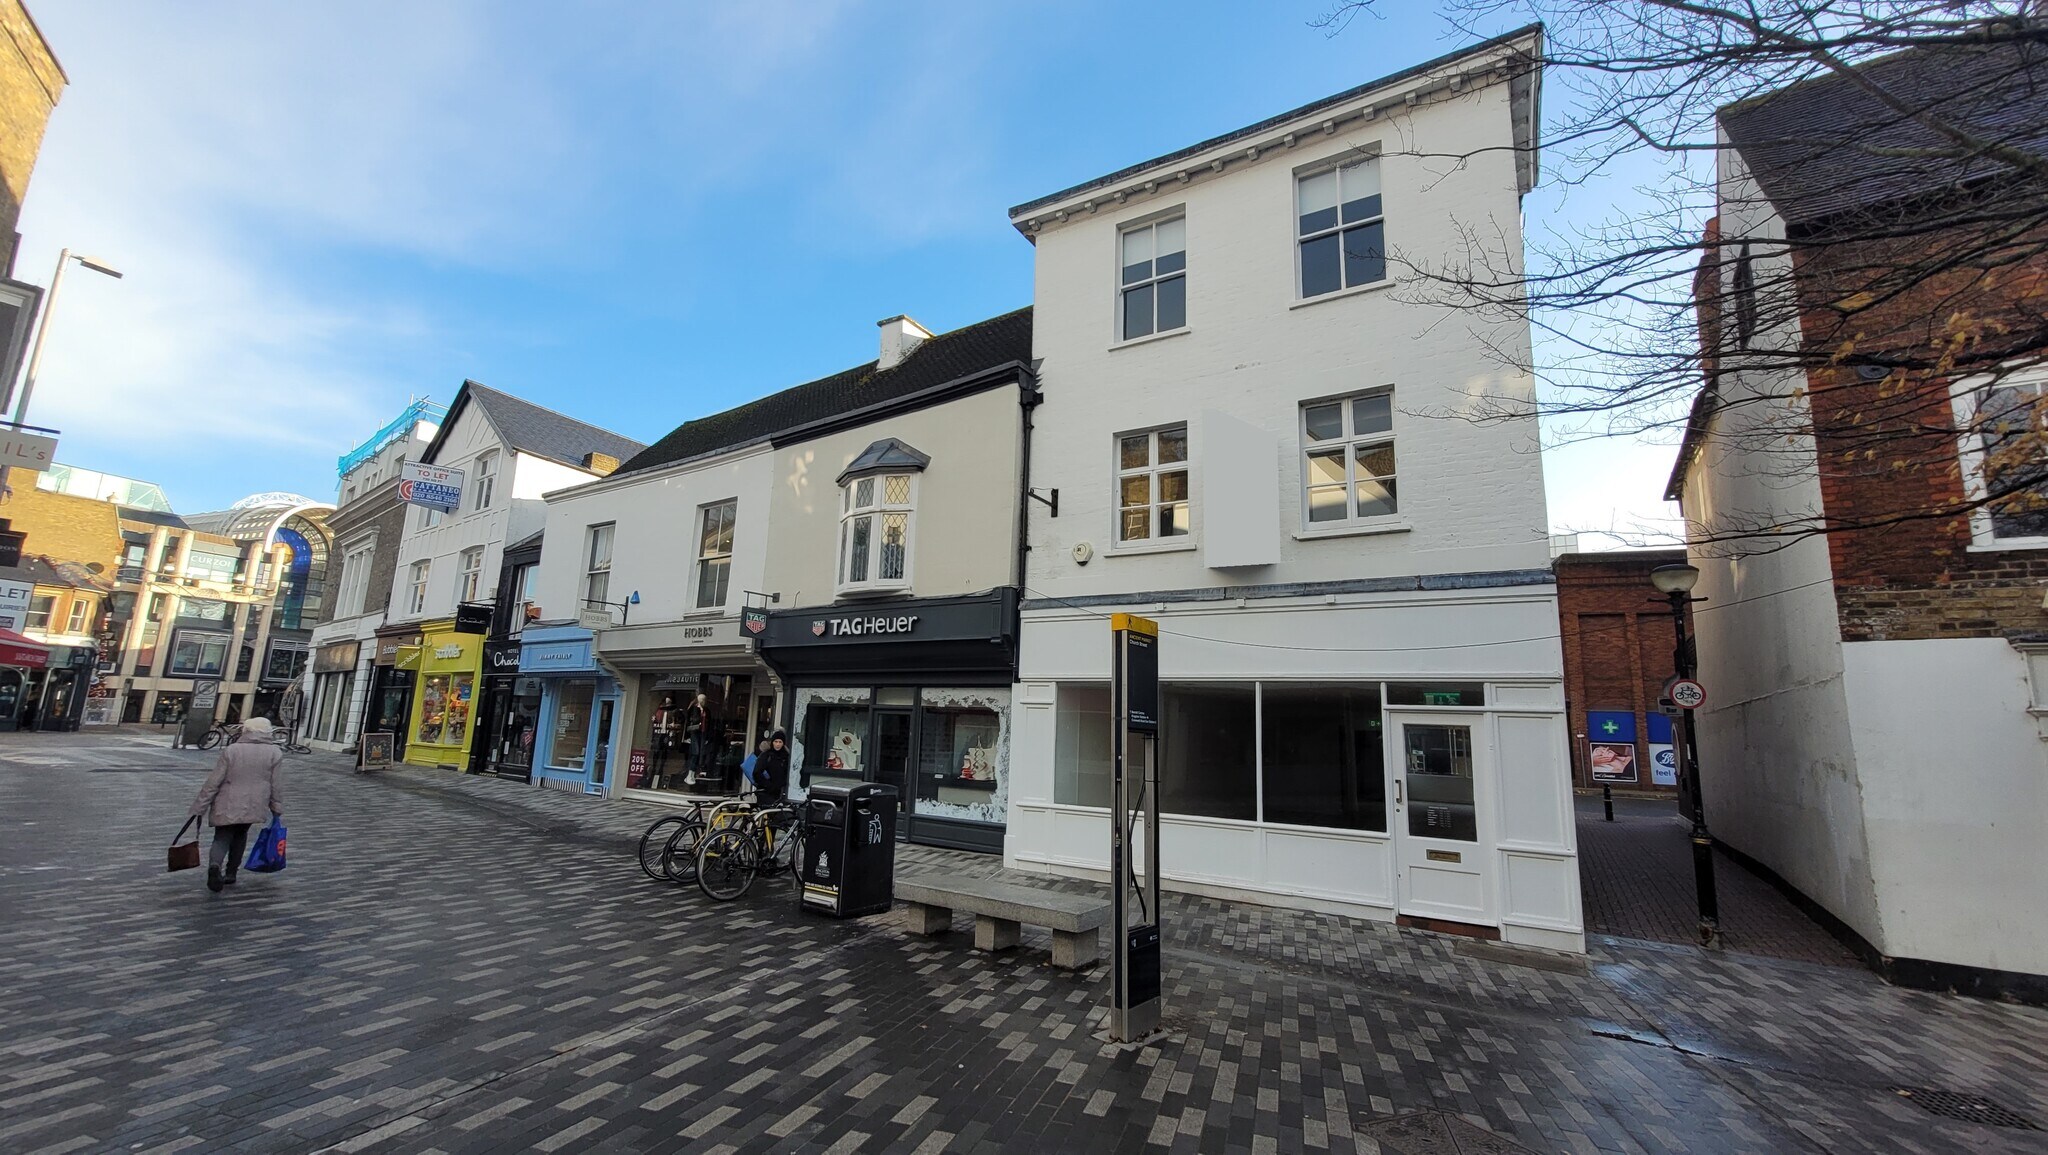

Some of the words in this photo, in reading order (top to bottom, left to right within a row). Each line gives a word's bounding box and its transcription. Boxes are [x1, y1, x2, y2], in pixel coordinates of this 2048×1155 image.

[417, 469, 431, 477] TO
[433, 472, 450, 480] LET
[414, 481, 460, 494] CATTANEO
[749, 614, 765, 622] TAG
[684, 626, 713, 638] HOBBS
[631, 755, 646, 764] 20%
[630, 764, 646, 773] OFF
[1655, 769, 1672, 777] feel
